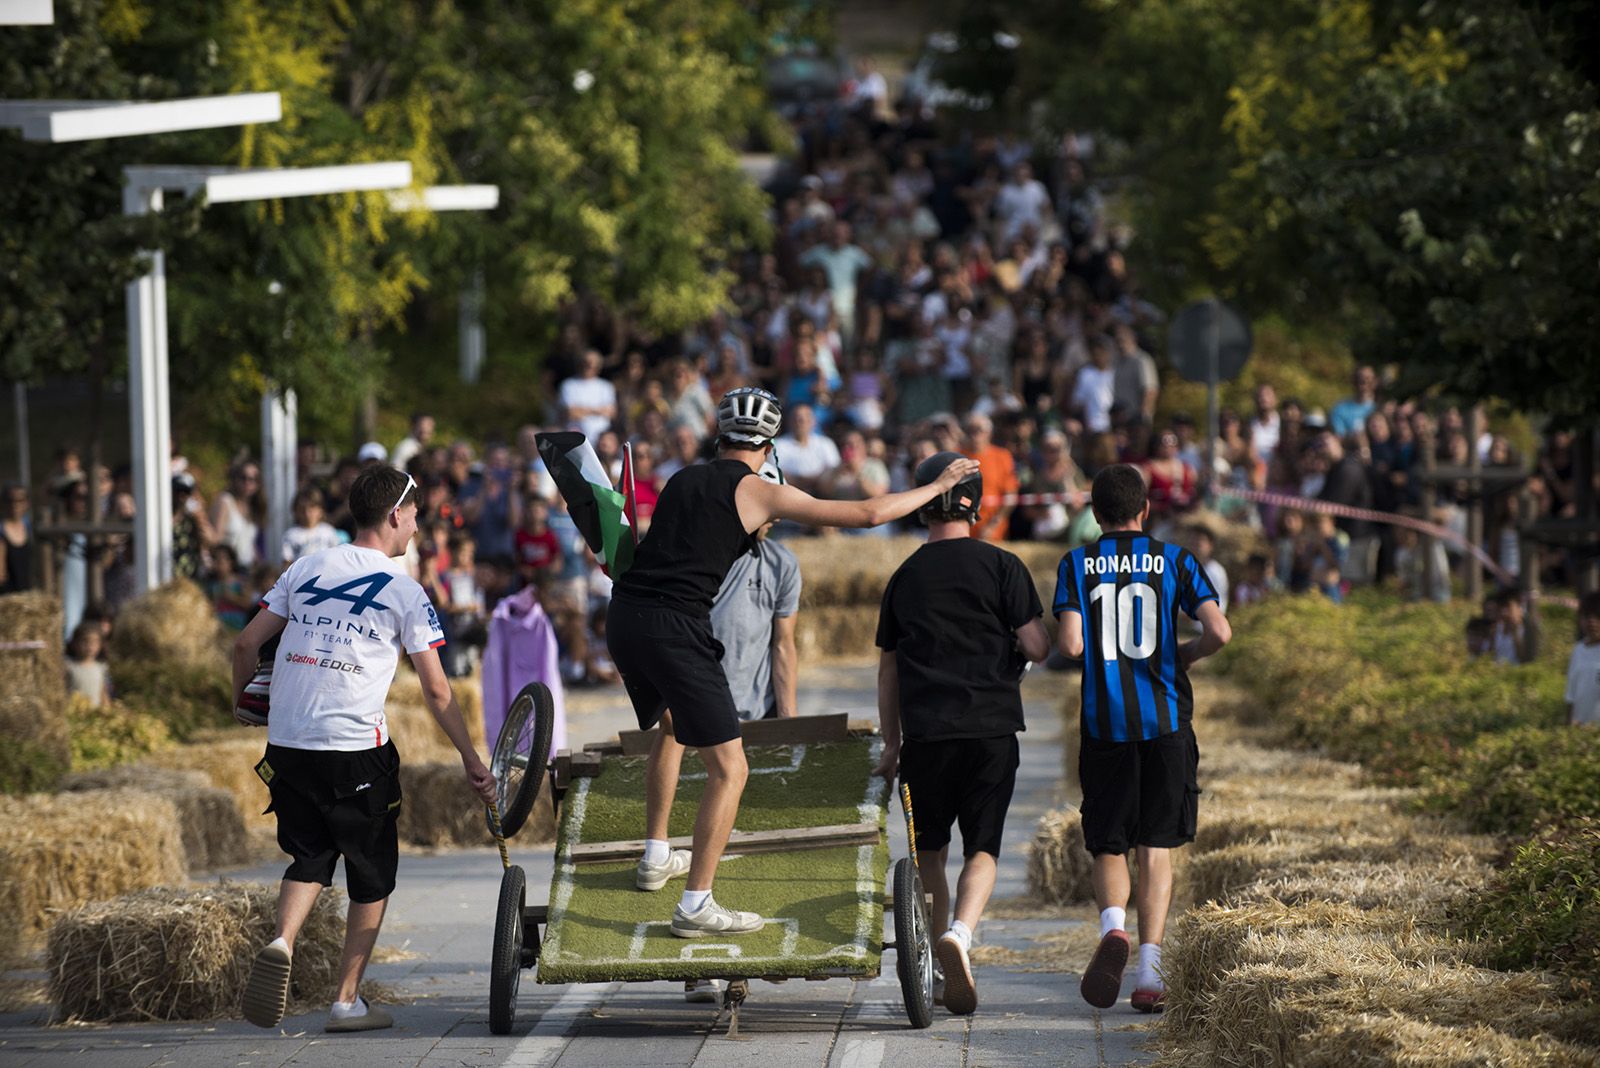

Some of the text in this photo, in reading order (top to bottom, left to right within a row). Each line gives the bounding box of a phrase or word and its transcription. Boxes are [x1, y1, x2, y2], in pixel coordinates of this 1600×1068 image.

[1083, 553, 1165, 576] RONALDO
[289, 612, 382, 642] ALPINE
[1089, 582, 1158, 661] 10
[322, 633, 353, 647] TEAM
[292, 653, 364, 675] Castrol EDGE
